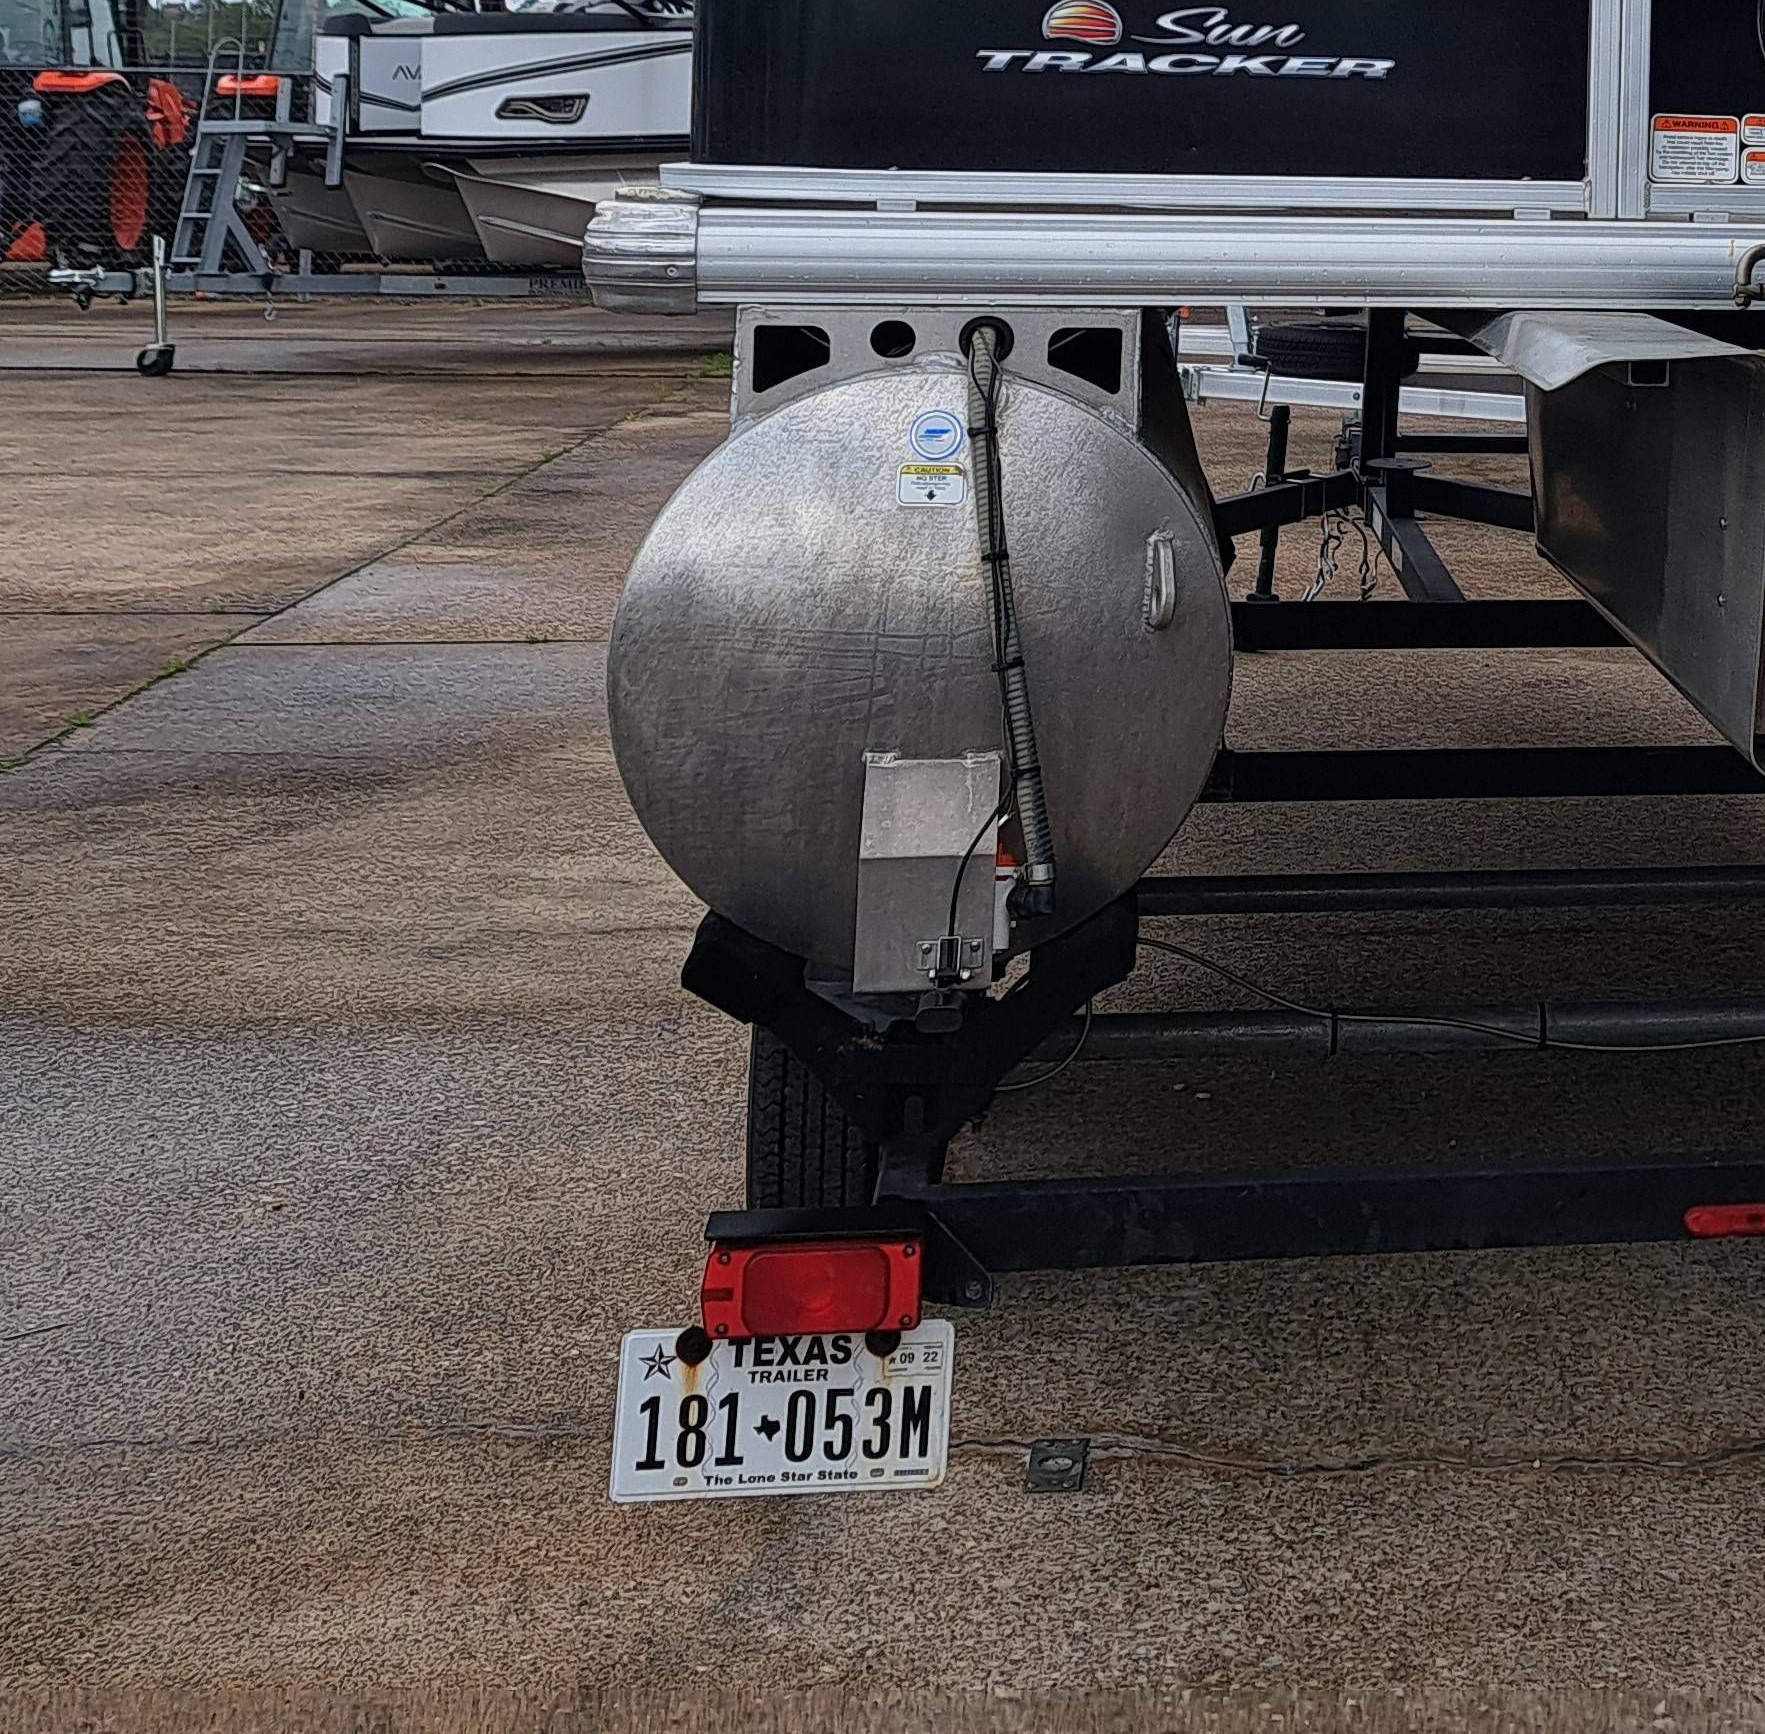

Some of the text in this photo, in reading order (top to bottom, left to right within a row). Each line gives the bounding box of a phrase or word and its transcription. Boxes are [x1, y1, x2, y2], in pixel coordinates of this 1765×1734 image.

[1130, 6, 1306, 48] Sun
[392, 65, 421, 80] AV
[975, 49, 1396, 80] TRACKER
[1671, 120, 1719, 129] WARNING
[914, 466, 951, 474] CAUTION
[728, 1335, 853, 1367] TEXAS
[899, 1351, 938, 1364] 09 22
[748, 1368, 829, 1384] TRAILER
[635, 1385, 932, 1471] 181 053M
[704, 1468, 858, 1486] The Lone Star State
